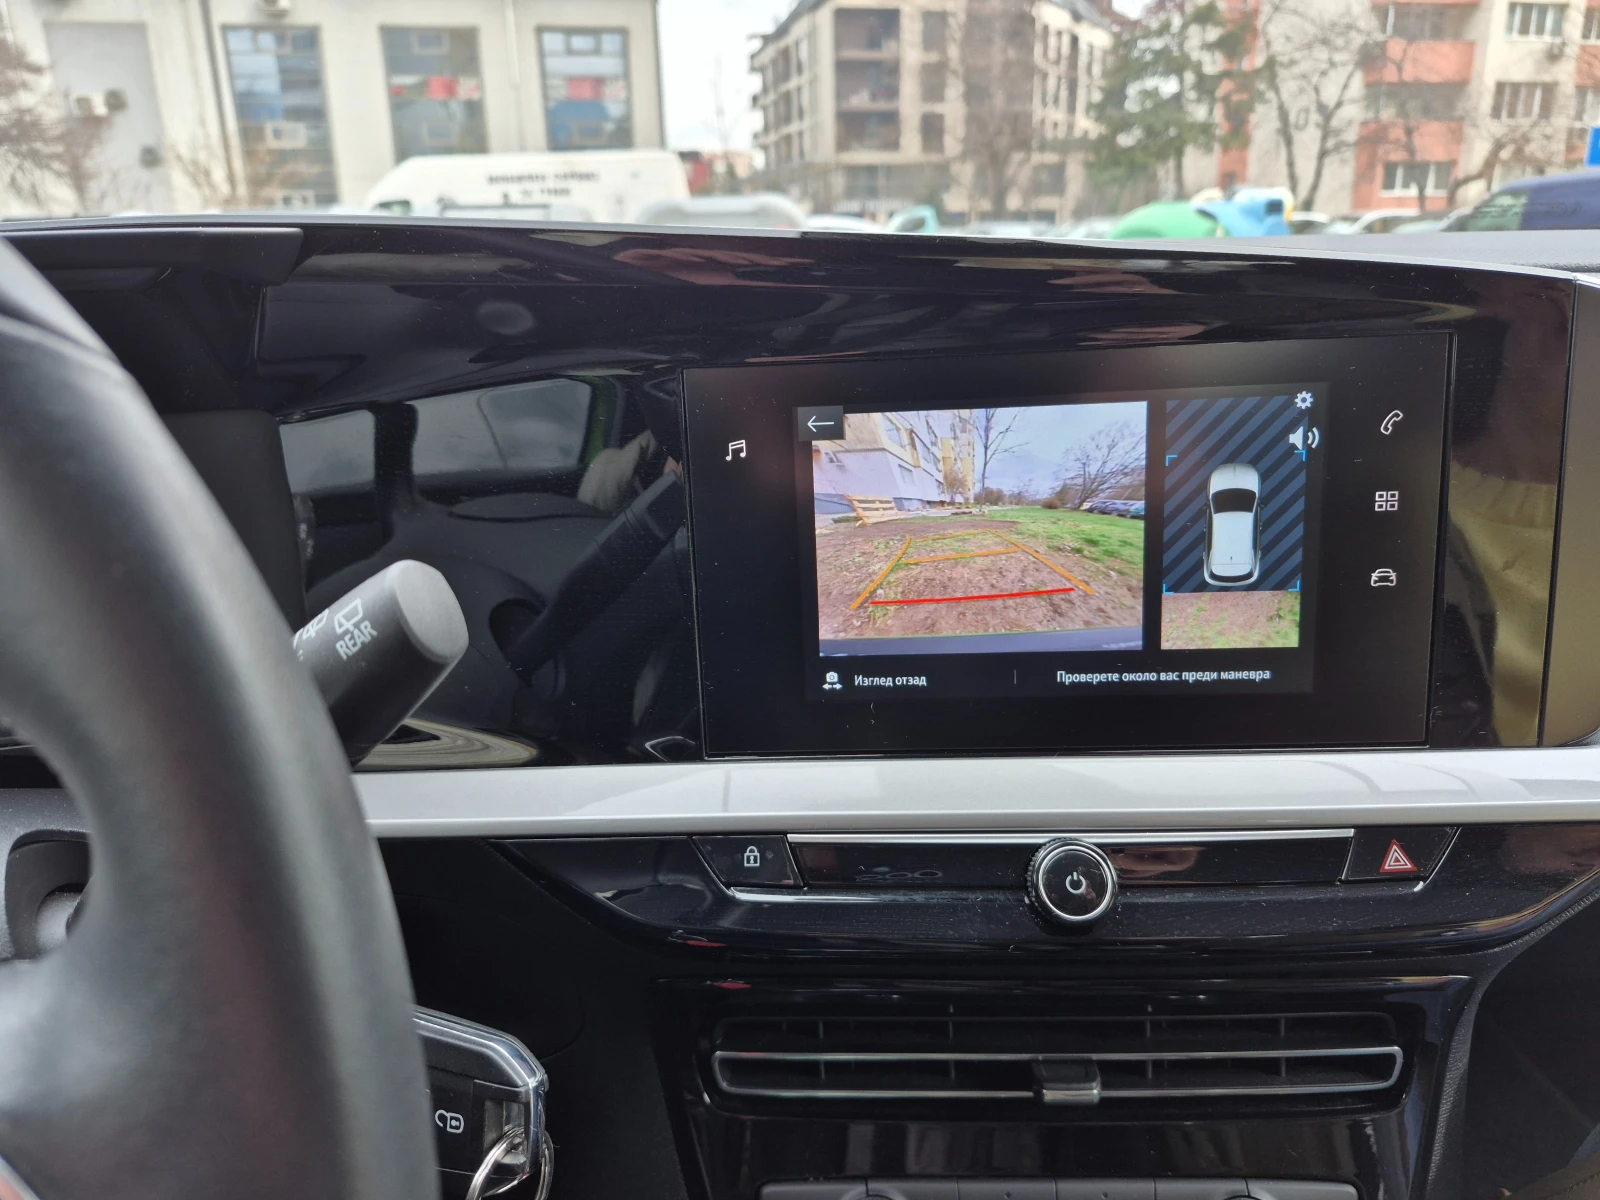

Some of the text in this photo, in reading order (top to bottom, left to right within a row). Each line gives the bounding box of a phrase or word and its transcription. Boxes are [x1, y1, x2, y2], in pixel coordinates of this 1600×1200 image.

[335, 620, 378, 661] REAR
[854, 674, 927, 687] Изглед отзад
[1057, 670, 1270, 685] Проверете около вас преди маневра
